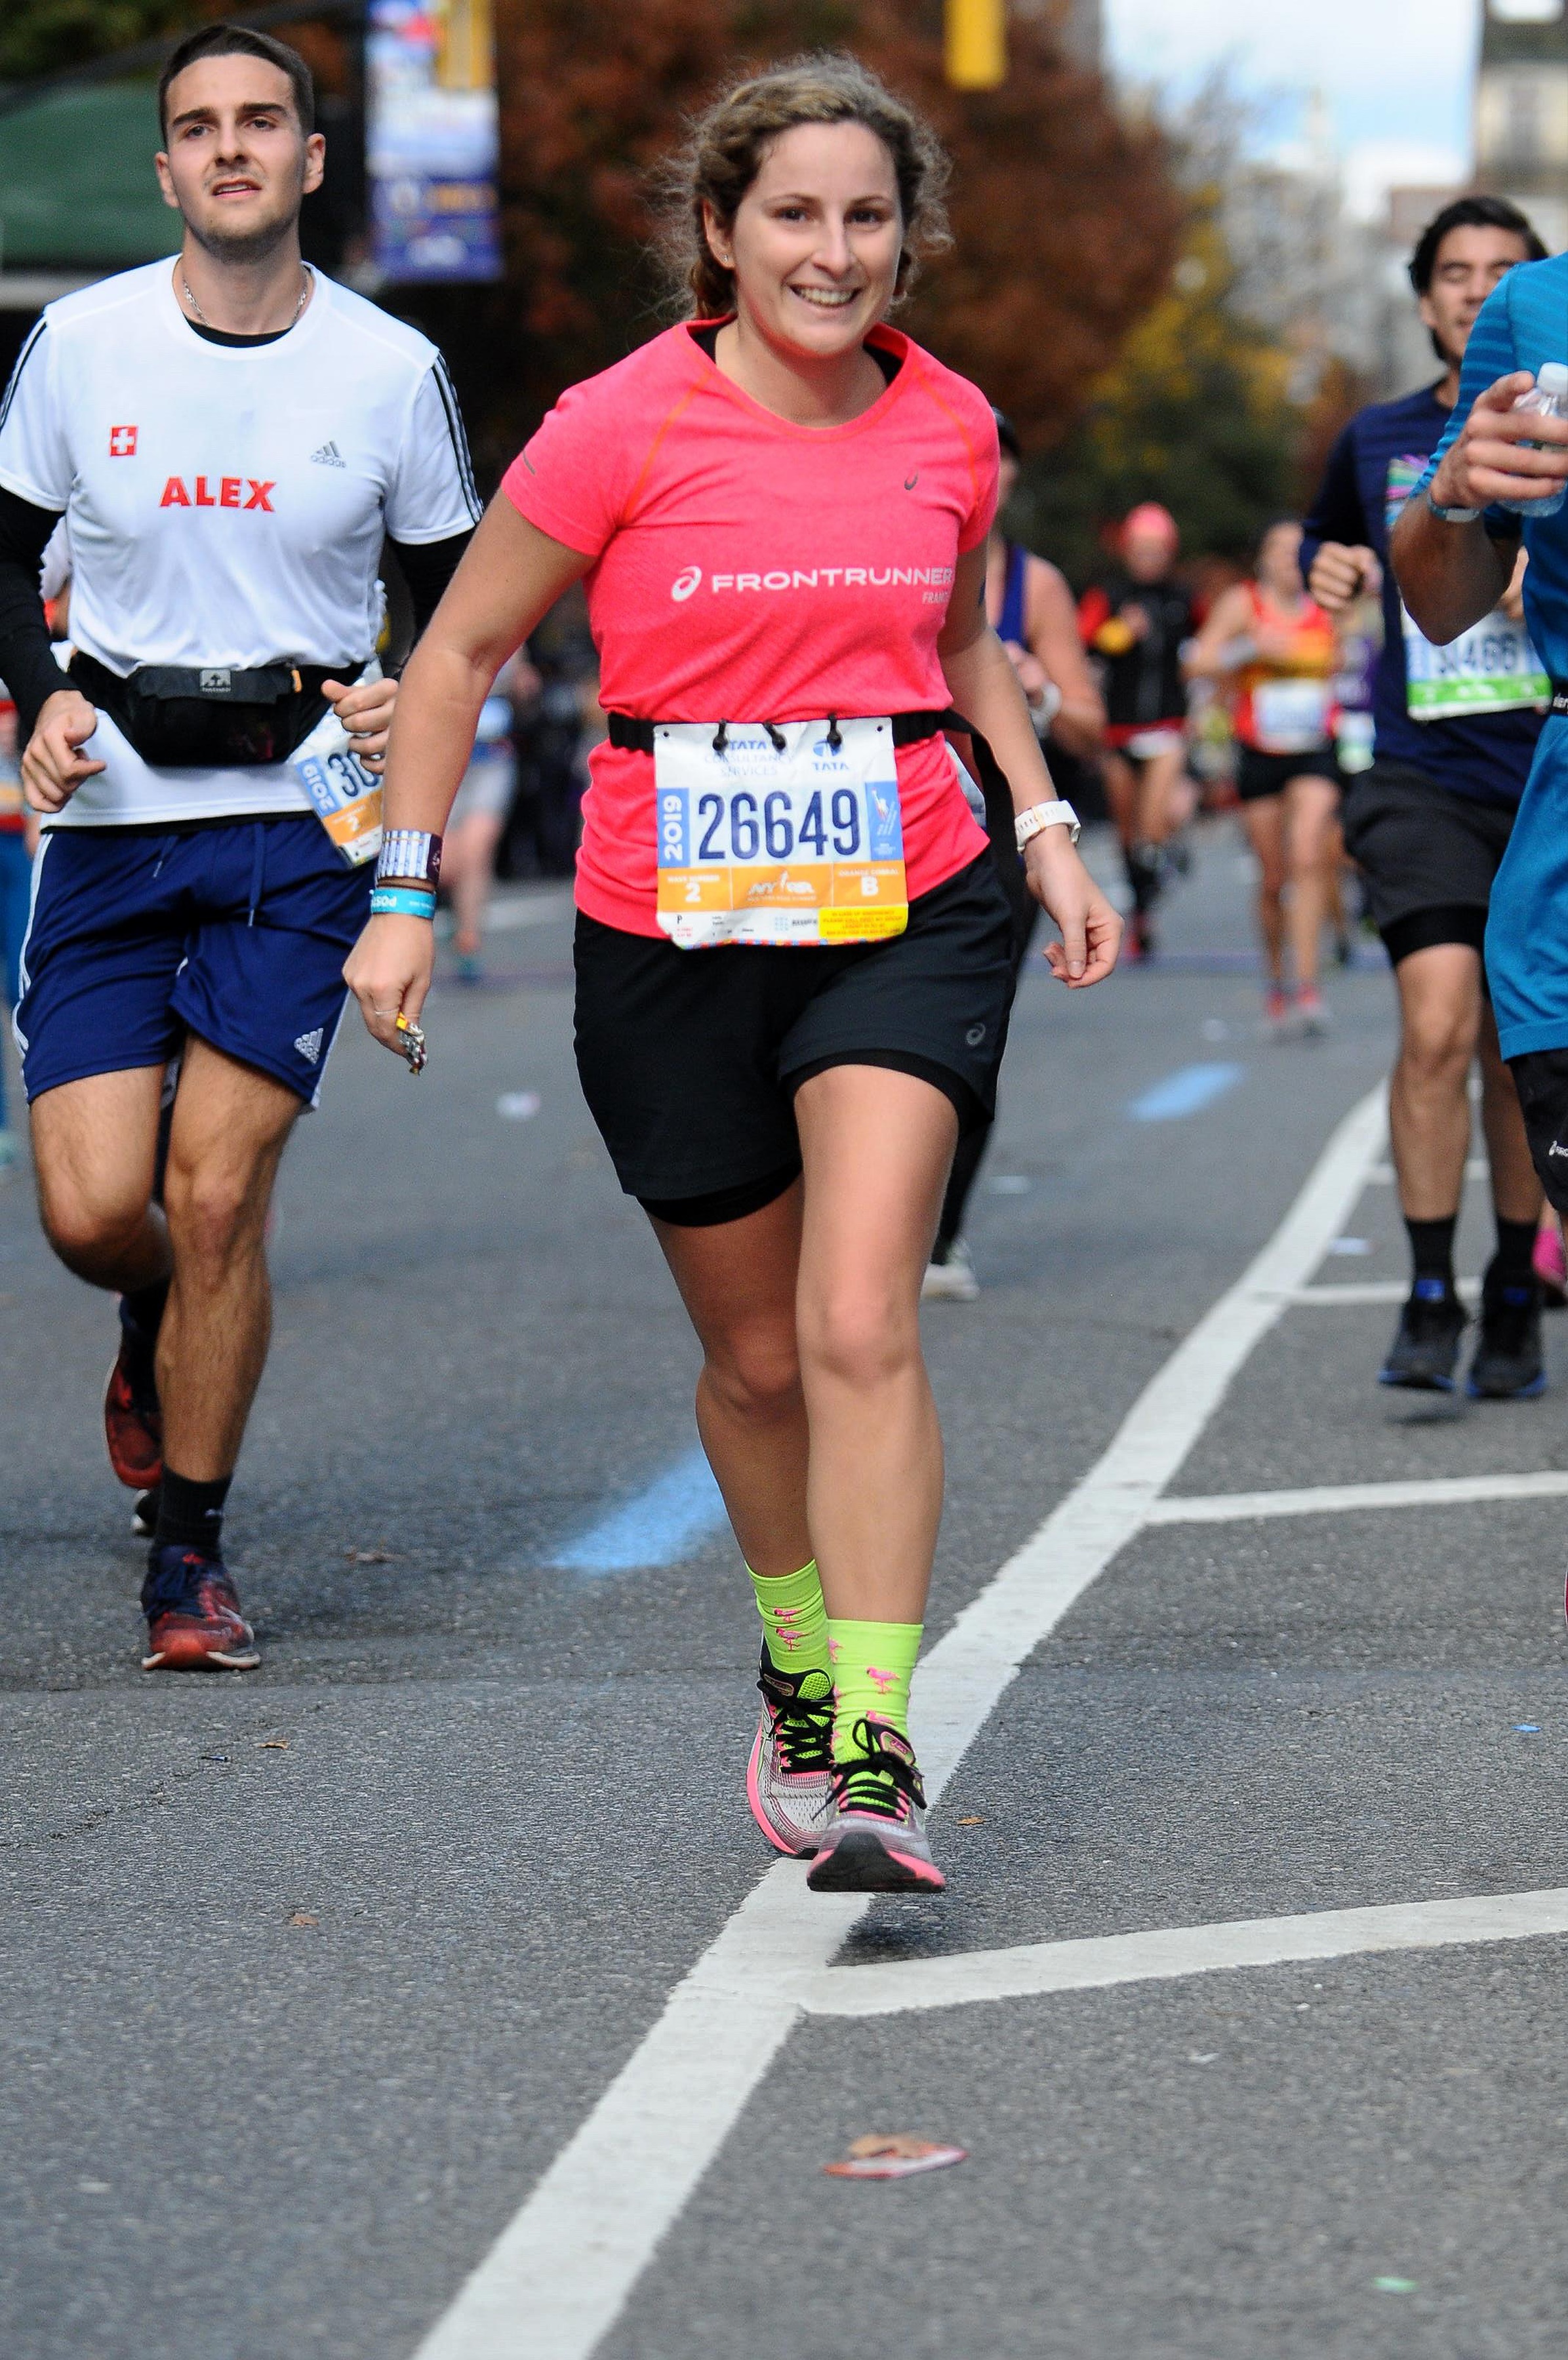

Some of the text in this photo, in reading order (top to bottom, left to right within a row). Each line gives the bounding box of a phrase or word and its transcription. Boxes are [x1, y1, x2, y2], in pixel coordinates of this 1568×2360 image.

[311, 454, 346, 468] adidas
[159, 475, 277, 512] ALEX
[712, 567, 954, 593] FRONTRUNNER
[729, 739, 767, 750] TATA
[812, 762, 849, 772] TATA
[302, 763, 336, 811] 2019
[664, 795, 683, 861] 2019
[698, 789, 860, 860] 26649
[685, 883, 701, 902] 2
[861, 876, 879, 896] B
